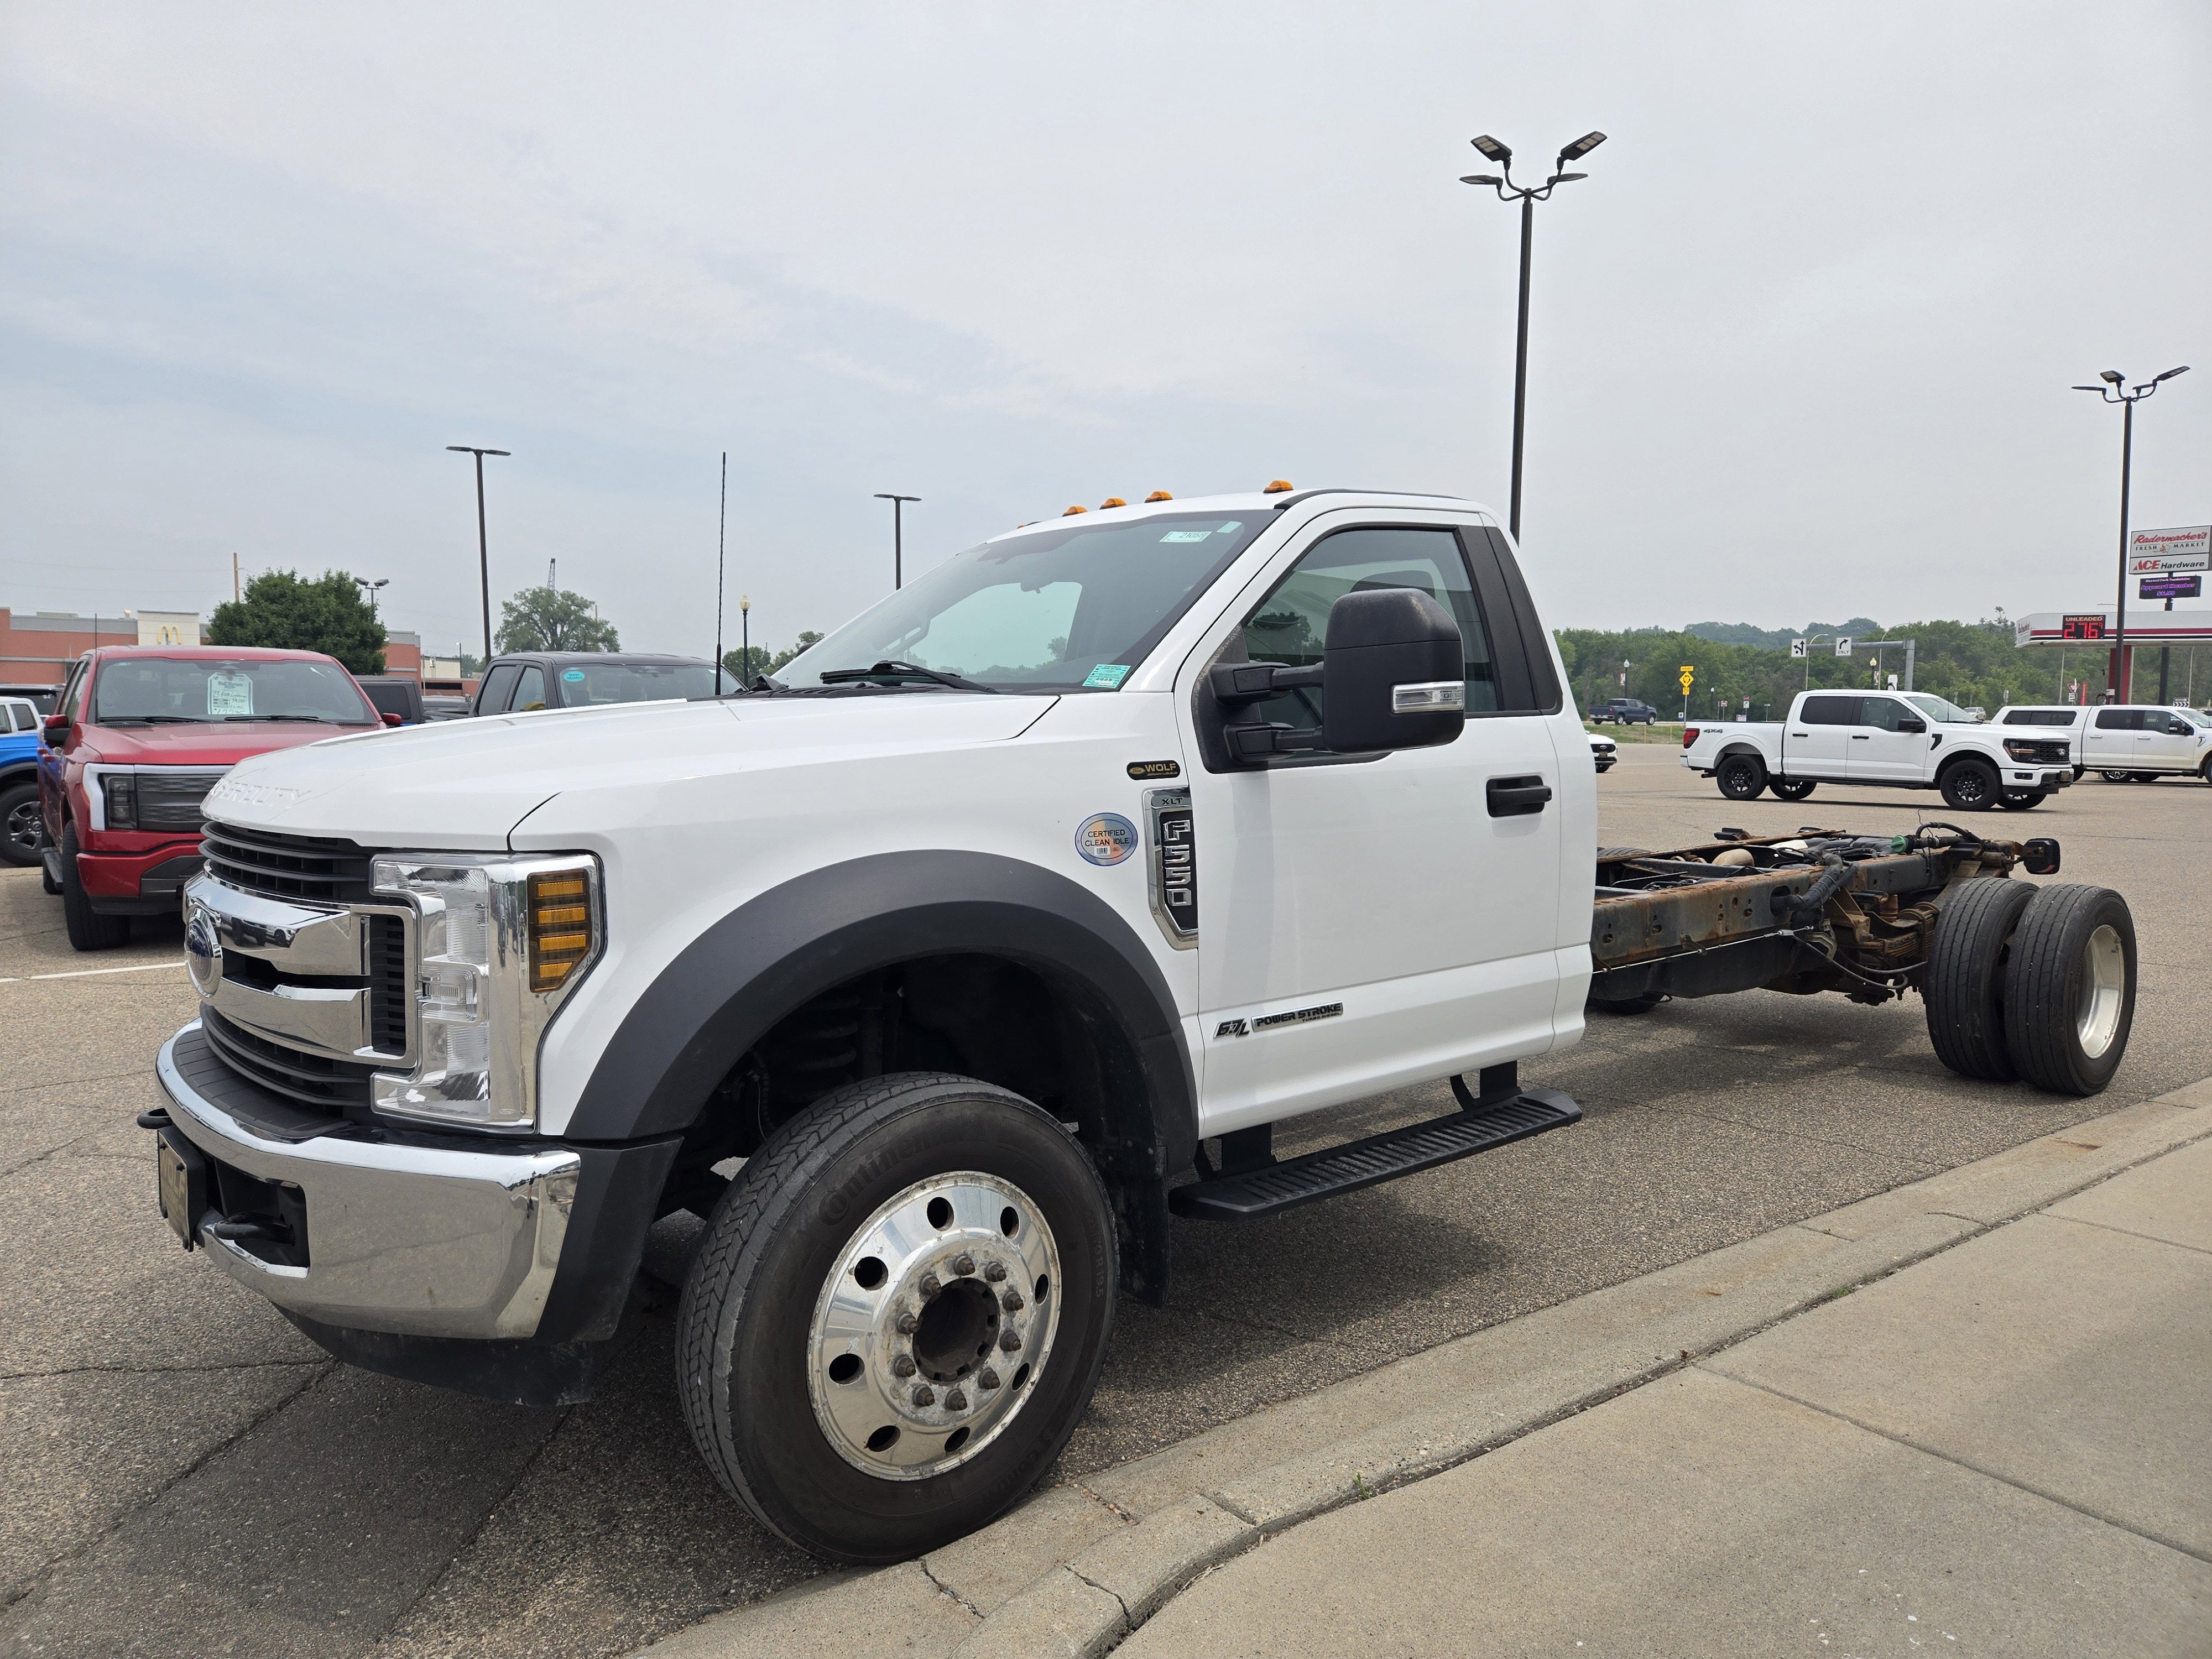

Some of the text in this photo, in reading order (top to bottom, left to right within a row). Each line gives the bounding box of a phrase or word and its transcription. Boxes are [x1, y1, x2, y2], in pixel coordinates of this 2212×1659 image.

[2134, 532, 2208, 544] Radermacher's
[2132, 560, 2161, 571] ACE
[1145, 763, 1176, 772] WOLF
[1256, 1003, 1341, 1027] POWER STROKE
